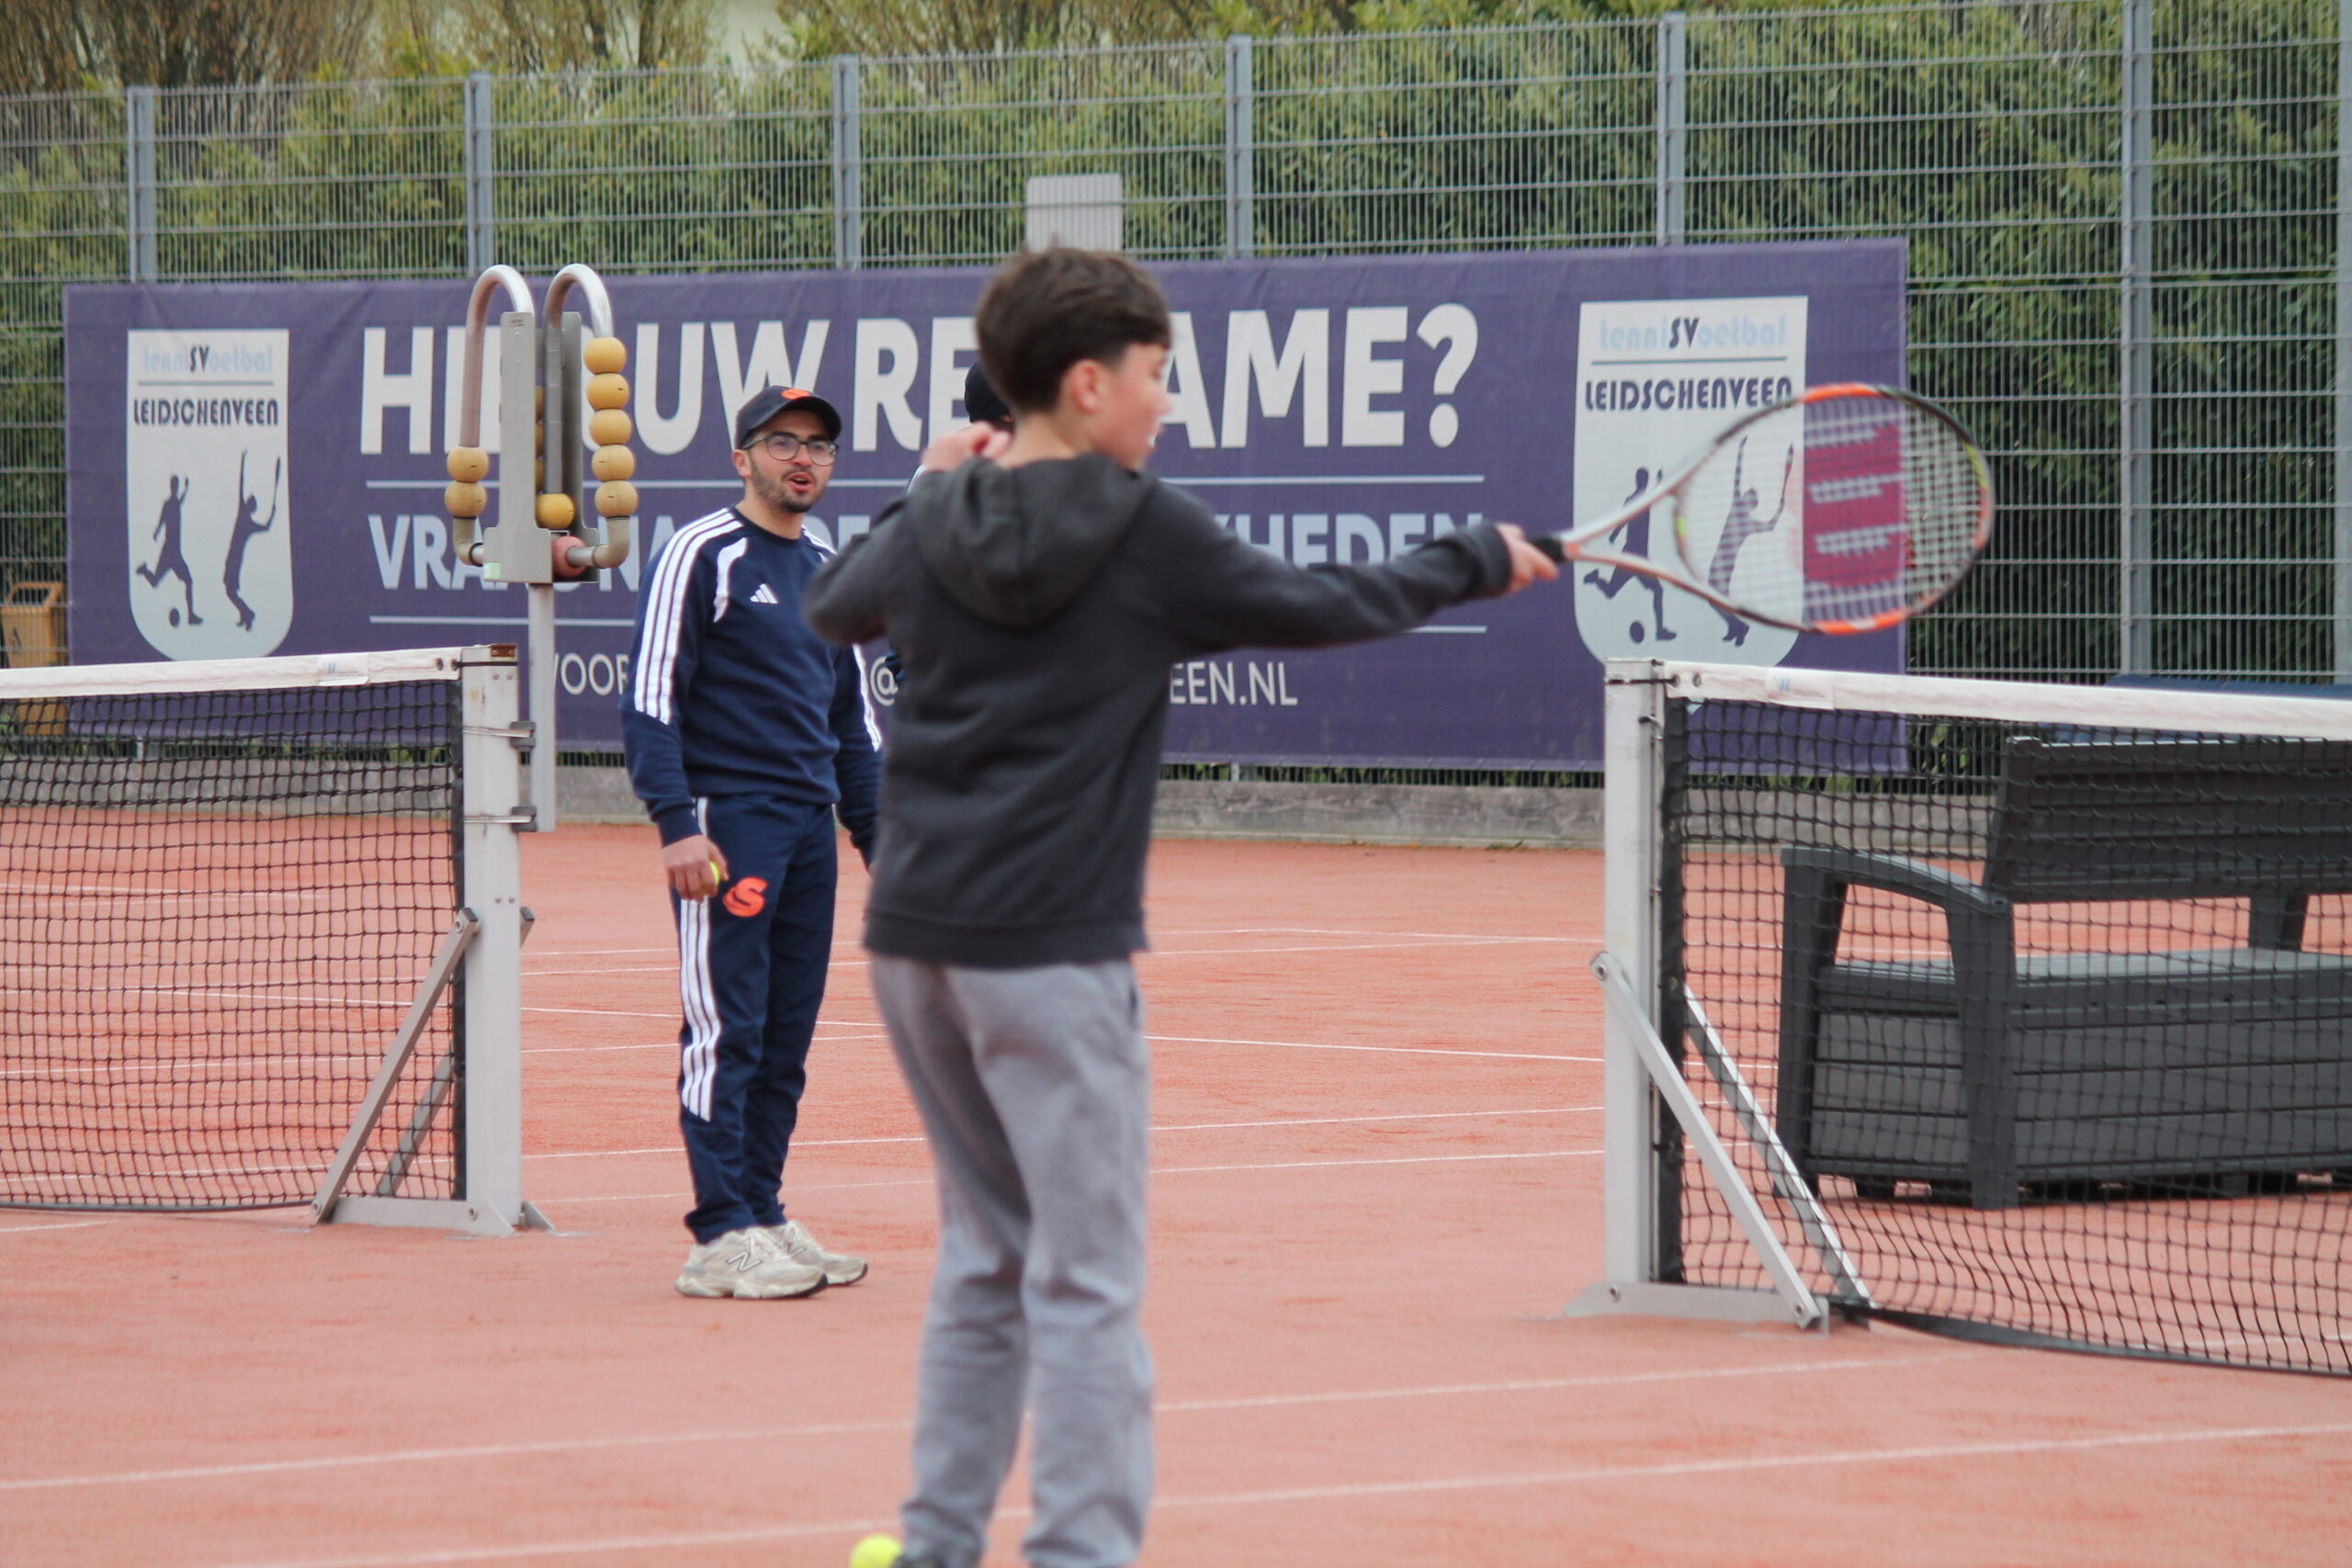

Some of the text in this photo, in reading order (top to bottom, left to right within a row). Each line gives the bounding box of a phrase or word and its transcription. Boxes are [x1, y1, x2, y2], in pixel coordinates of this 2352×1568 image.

[634, 320, 831, 456] UW
[853, 302, 1478, 453] REAME?
[1586, 376, 1792, 412] LEIDSCHENVEEN
[133, 398, 279, 426] LEIDSCHENVEEN
